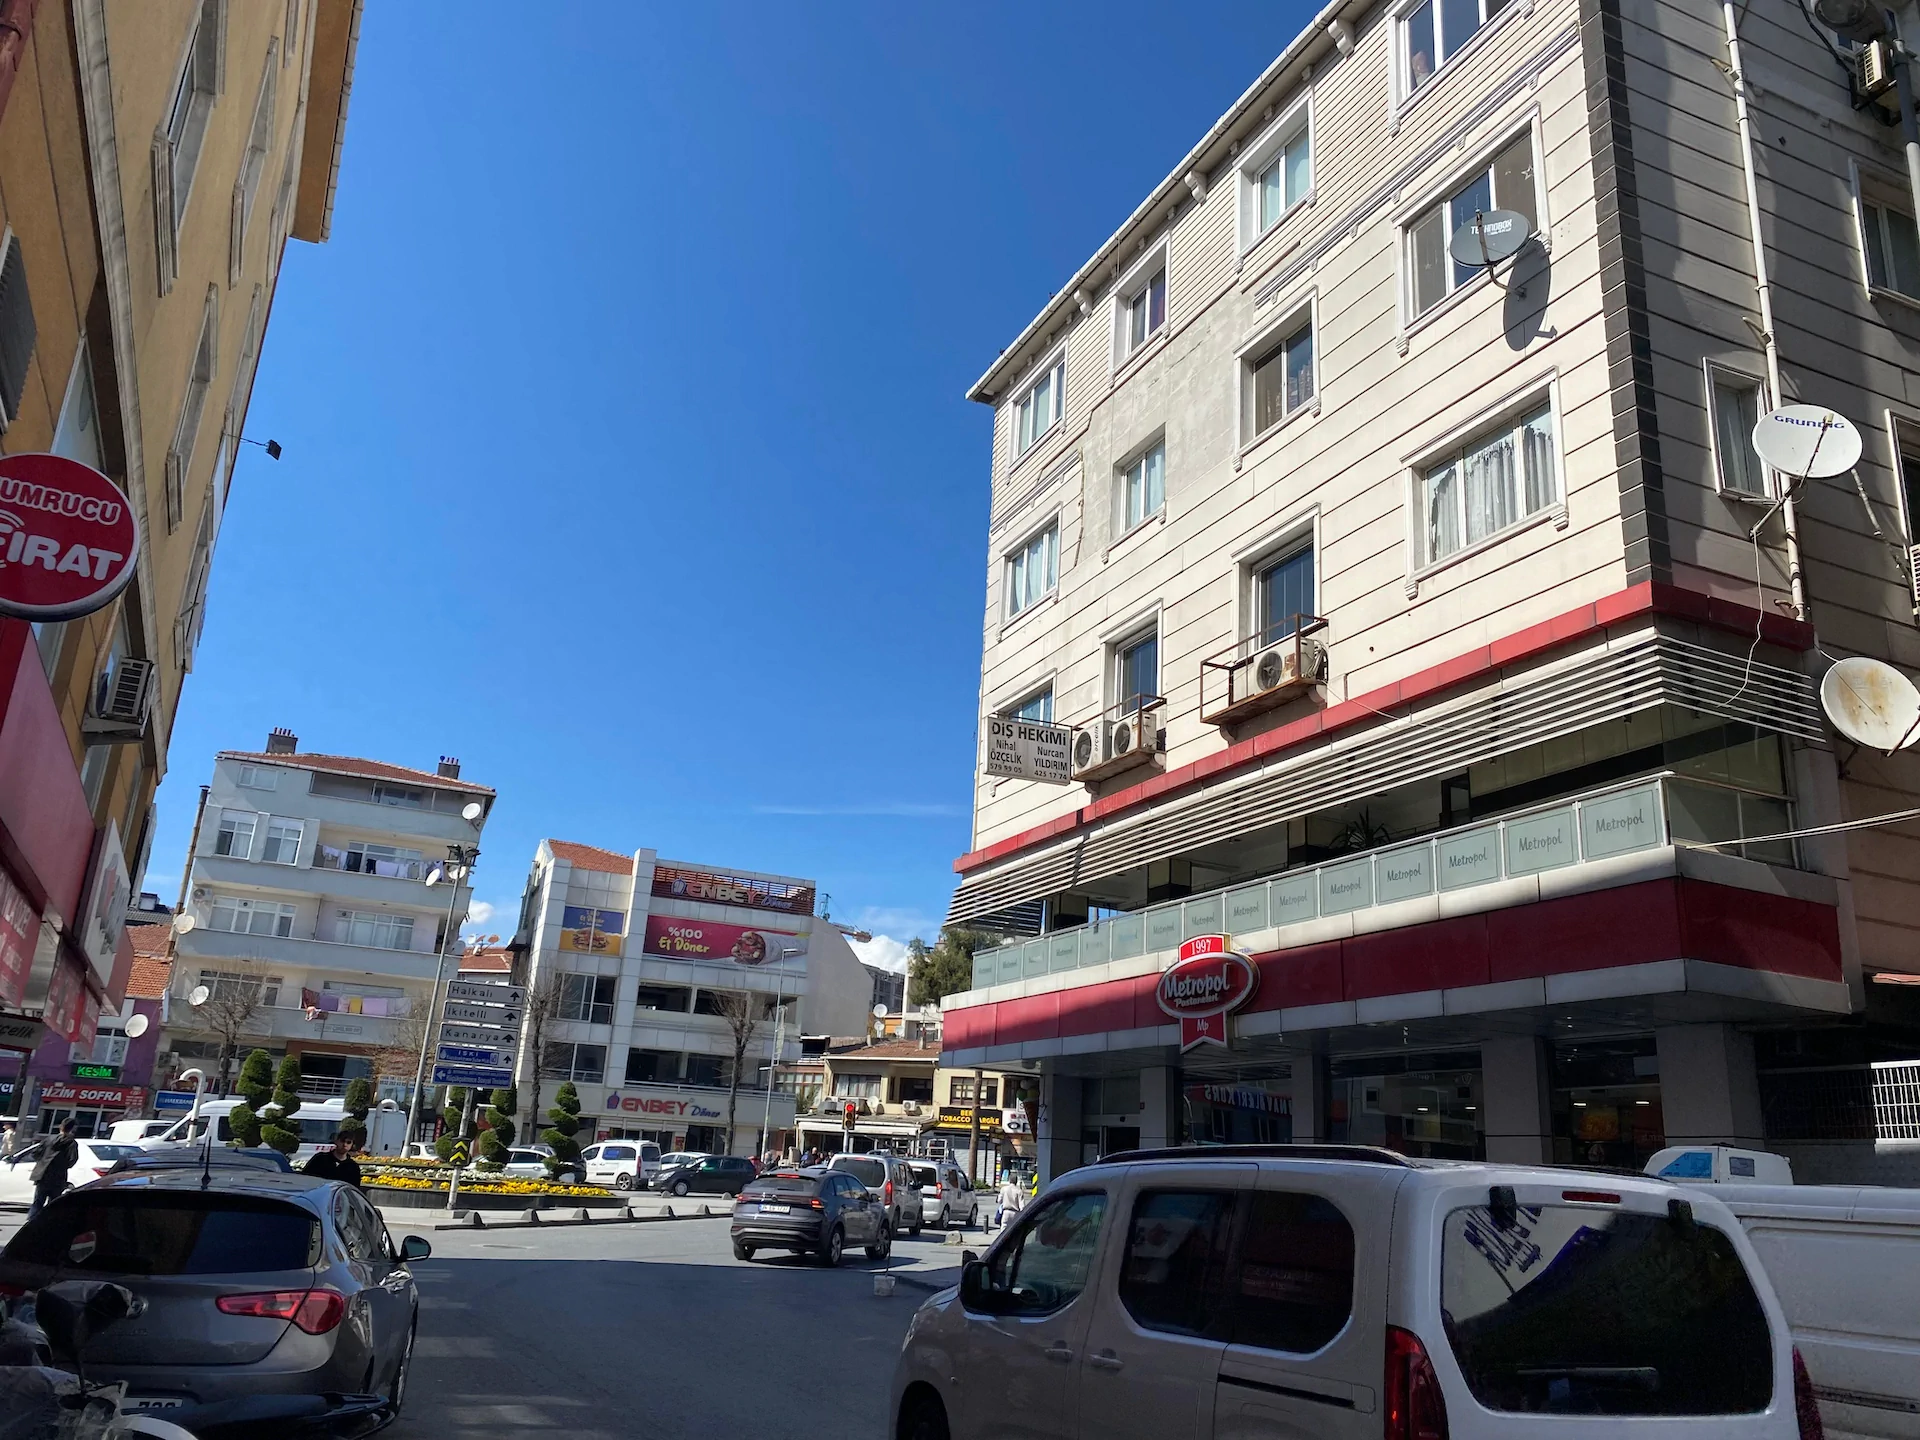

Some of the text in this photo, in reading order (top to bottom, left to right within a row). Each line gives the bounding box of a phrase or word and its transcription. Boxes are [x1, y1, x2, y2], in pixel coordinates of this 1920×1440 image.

[1470, 218, 1513, 235] TEHNOBOX
[996, 739, 1016, 752] Nihal
[1037, 746, 1065, 759] Nurcan
[1033, 757, 1068, 772] YILDIRIM
[1595, 808, 1645, 833] Metropol
[1518, 828, 1563, 853] Metropol
[1448, 846, 1488, 870] Metropol
[1386, 862, 1422, 884] Metropol
[687, 883, 759, 905] ENBEY
[1330, 876, 1362, 896] Metropol
[1279, 890, 1308, 908] Metropol
[1233, 901, 1260, 918] Metropol
[668, 925, 703, 940] %100
[658, 936, 710, 954] Et Döner
[1191, 939, 1212, 955] 1997
[1165, 963, 1230, 999] Metropol
[452, 986, 493, 998] Halkalı
[445, 1028, 499, 1042] Kanarya
[76, 1065, 112, 1077] KESİM
[78, 1088, 122, 1102] SOFRA
[621, 1096, 721, 1119] ENBEY Döner
[940, 1115, 971, 1124] TOBACCO
[979, 1116, 1000, 1125] ARGİLE
